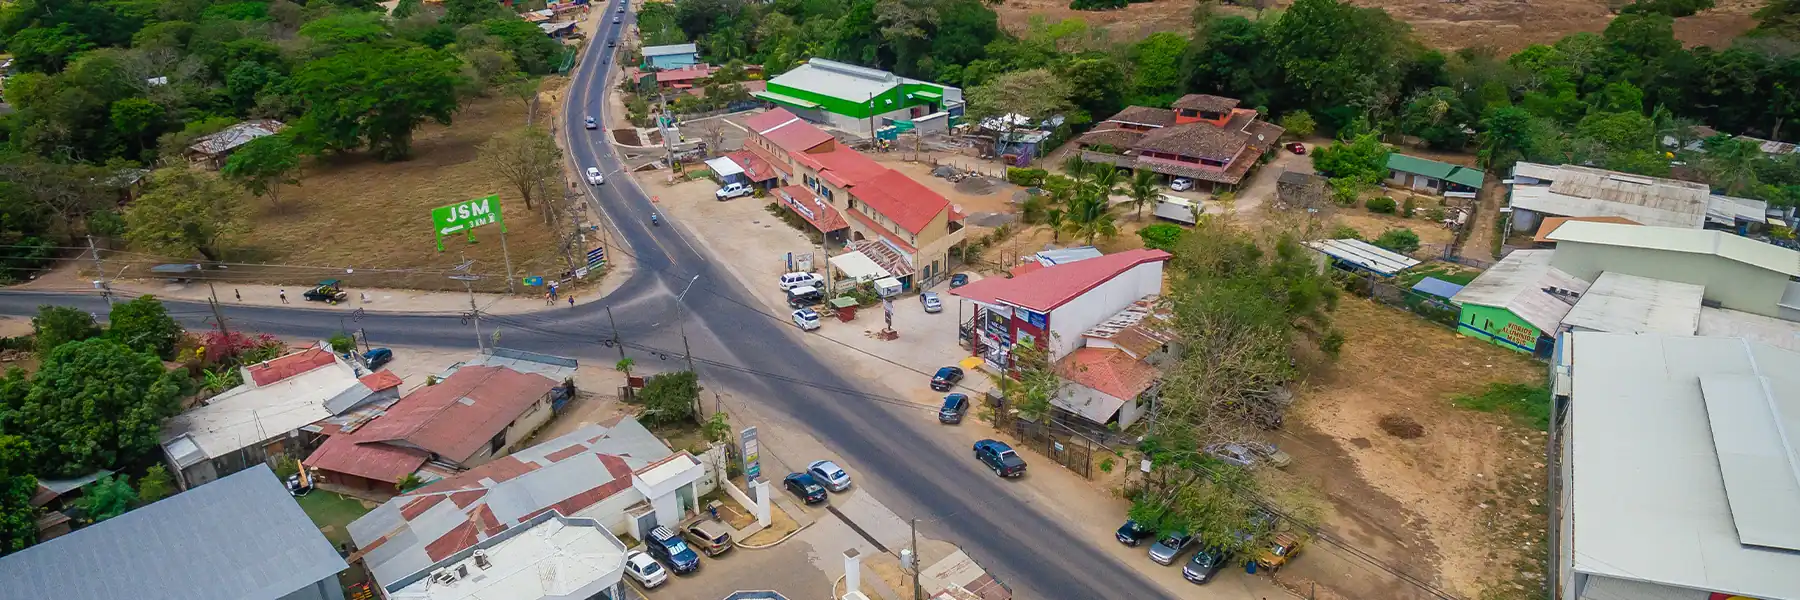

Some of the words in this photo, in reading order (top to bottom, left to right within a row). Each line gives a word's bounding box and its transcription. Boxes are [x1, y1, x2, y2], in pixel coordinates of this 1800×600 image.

[446, 199, 490, 222] JSM
[468, 220, 474, 228] 3
[475, 217, 487, 226] KM
[1508, 322, 1533, 336] VIDRIOS
